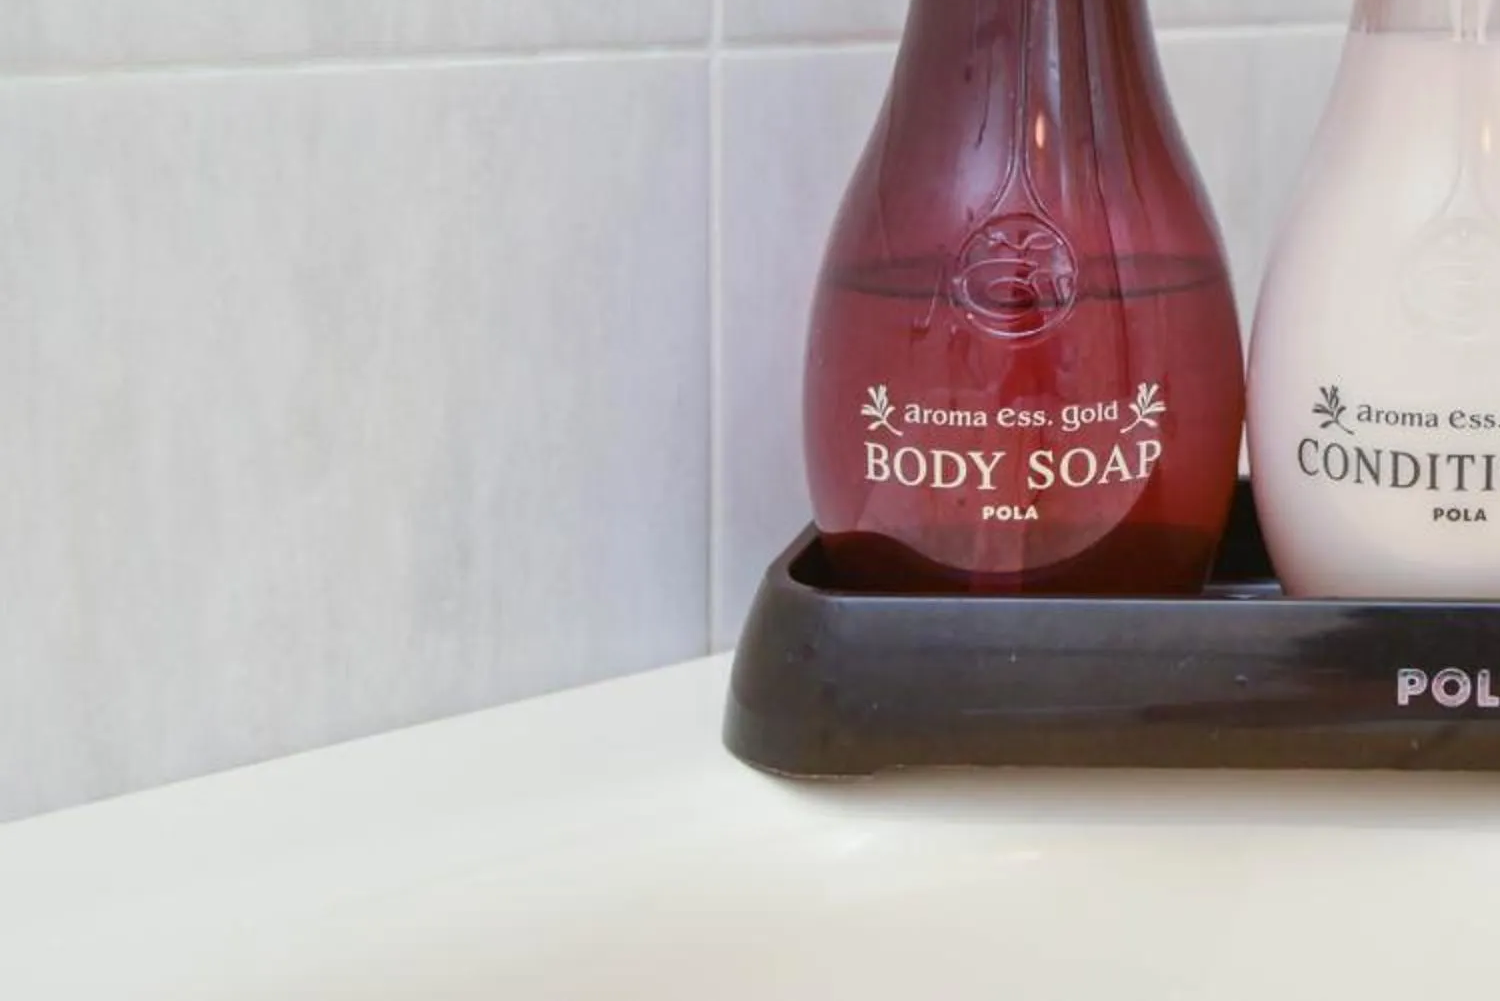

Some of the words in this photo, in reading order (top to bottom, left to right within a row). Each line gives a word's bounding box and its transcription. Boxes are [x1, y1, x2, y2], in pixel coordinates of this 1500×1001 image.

[904, 403, 988, 427] aroma
[996, 406, 1054, 427] ess.
[1061, 401, 1119, 432] gold
[1356, 403, 1439, 428] aroma
[863, 441, 1006, 491] BODY
[1027, 439, 1163, 491] SOAP
[982, 505, 1039, 521] POLA
[1432, 507, 1488, 522] POLA
